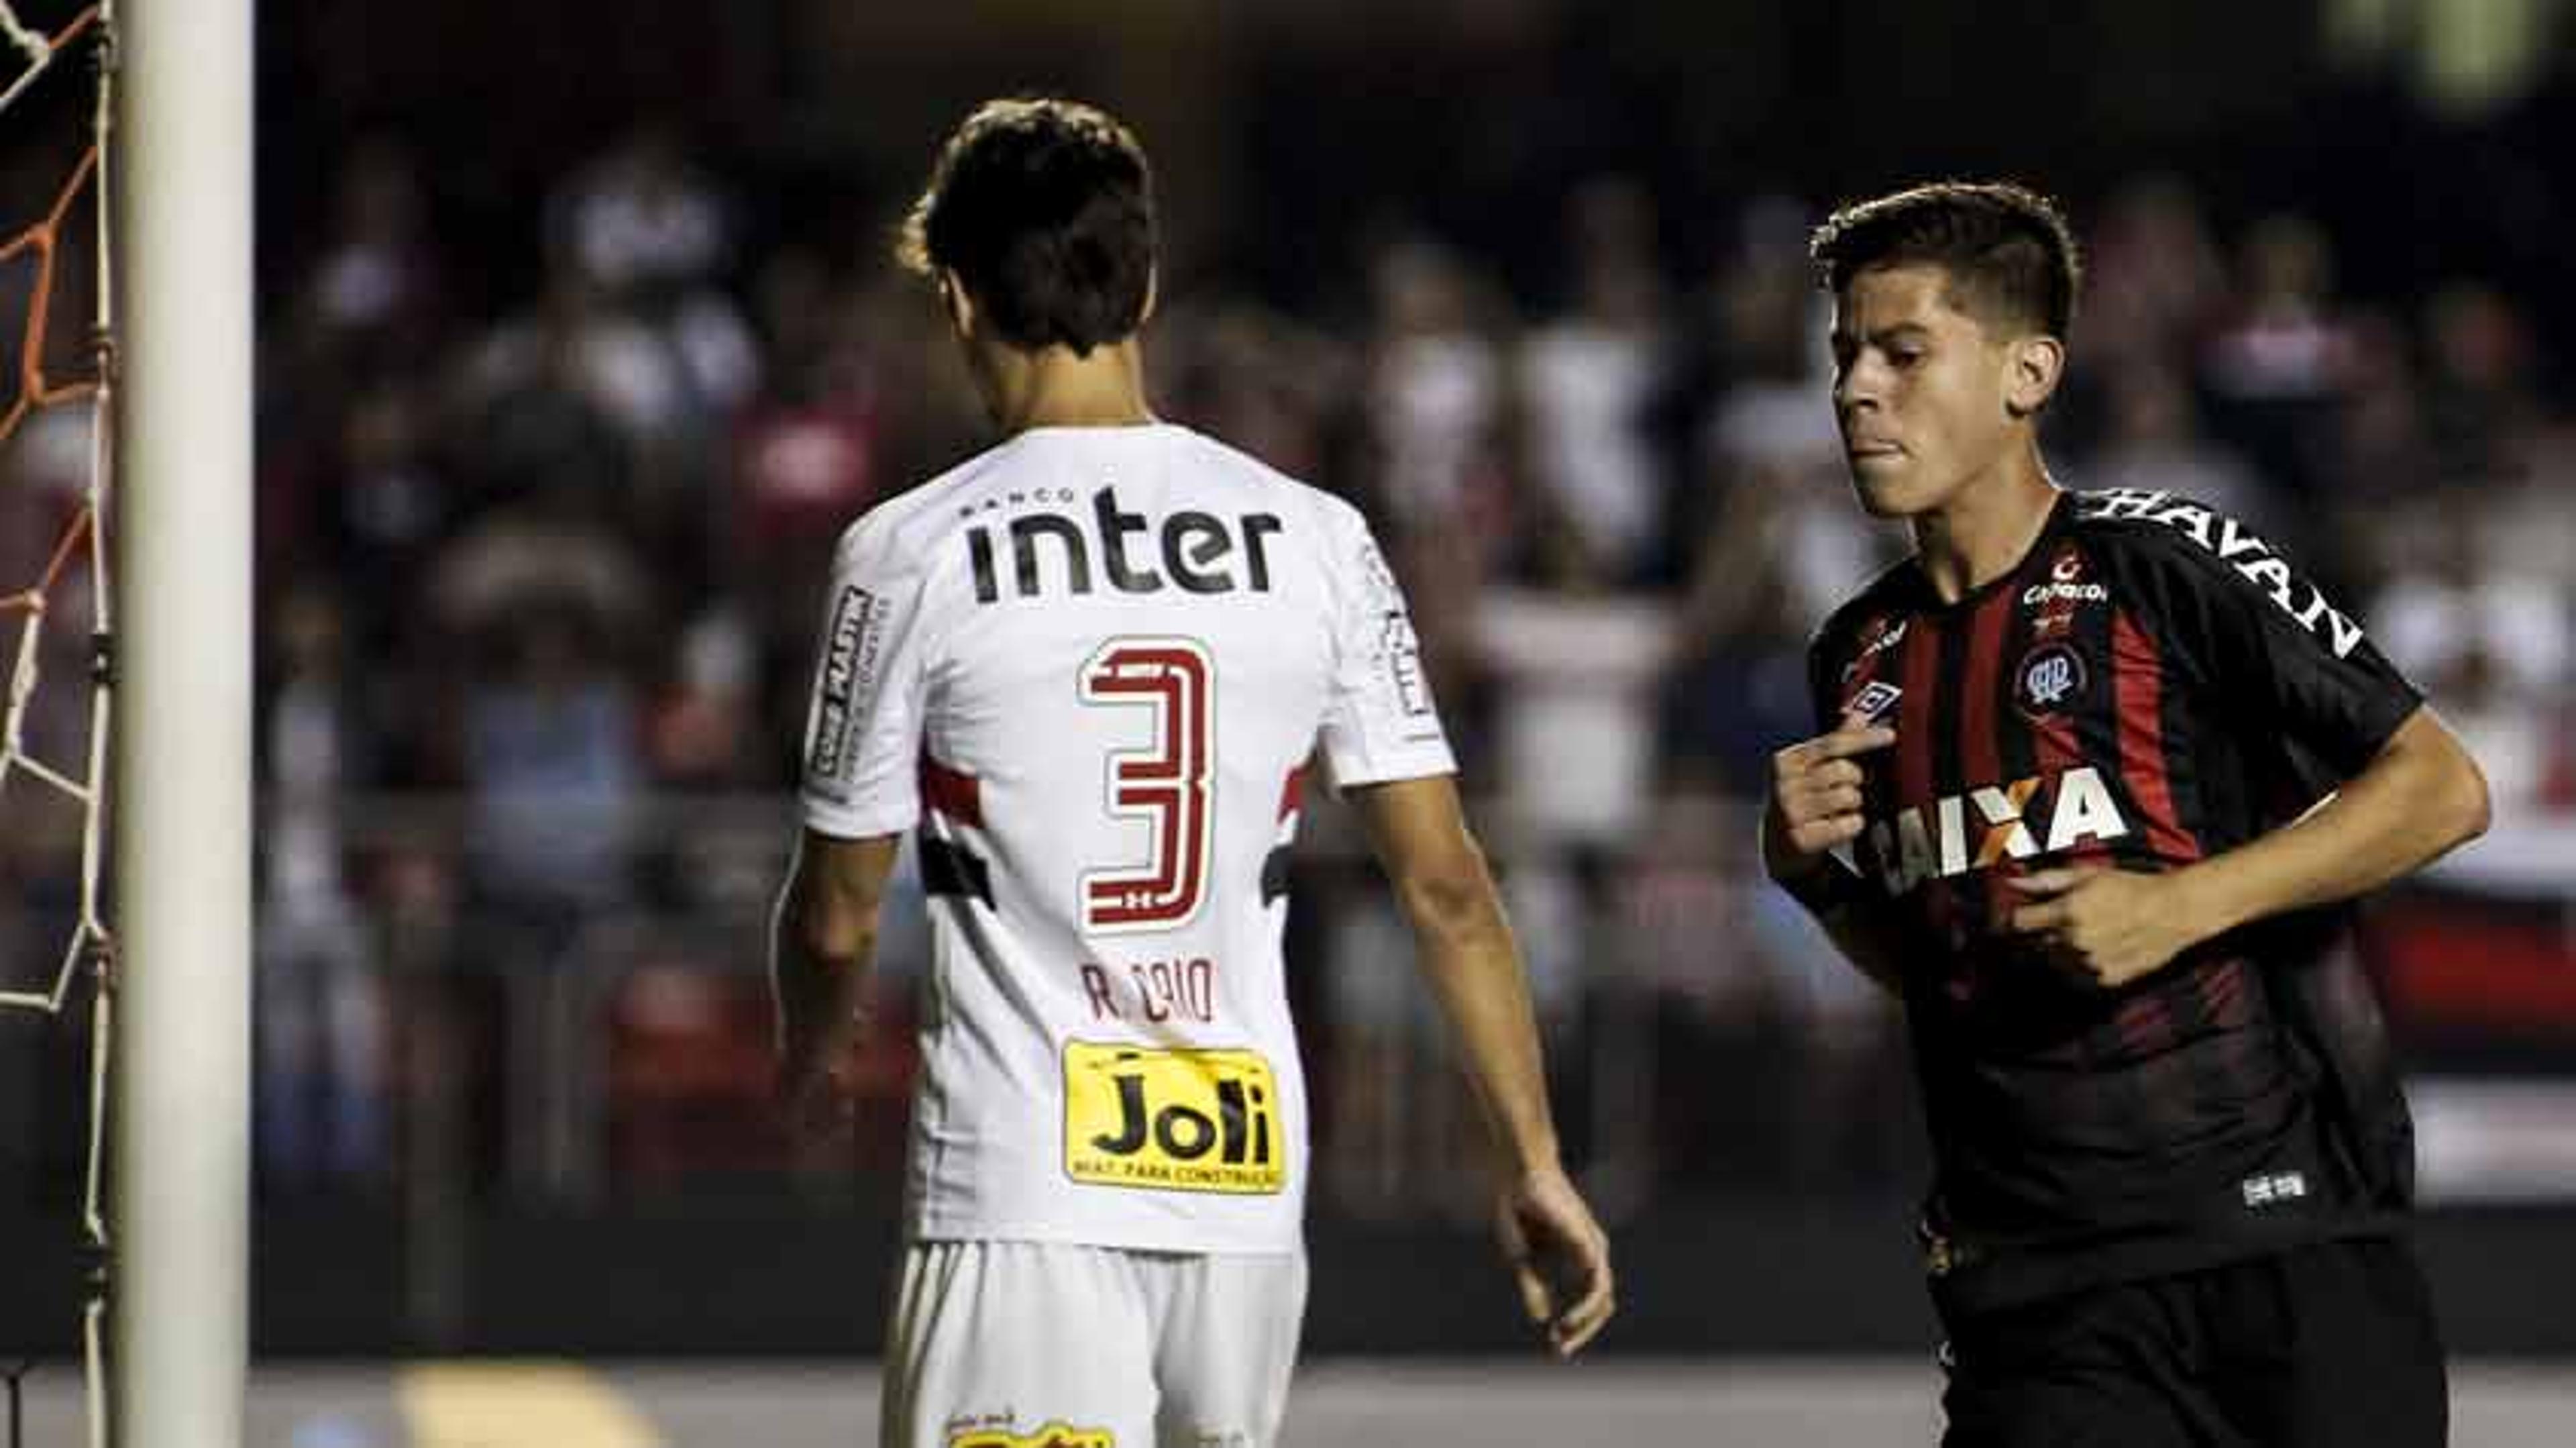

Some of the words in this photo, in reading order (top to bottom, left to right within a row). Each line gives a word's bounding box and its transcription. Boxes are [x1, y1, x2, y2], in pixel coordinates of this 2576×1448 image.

[966, 484, 1282, 604] inter
[2089, 488, 2363, 660] HAVAN
[1081, 639, 1213, 931] 3
[1090, 1074, 1269, 1164] Joli
